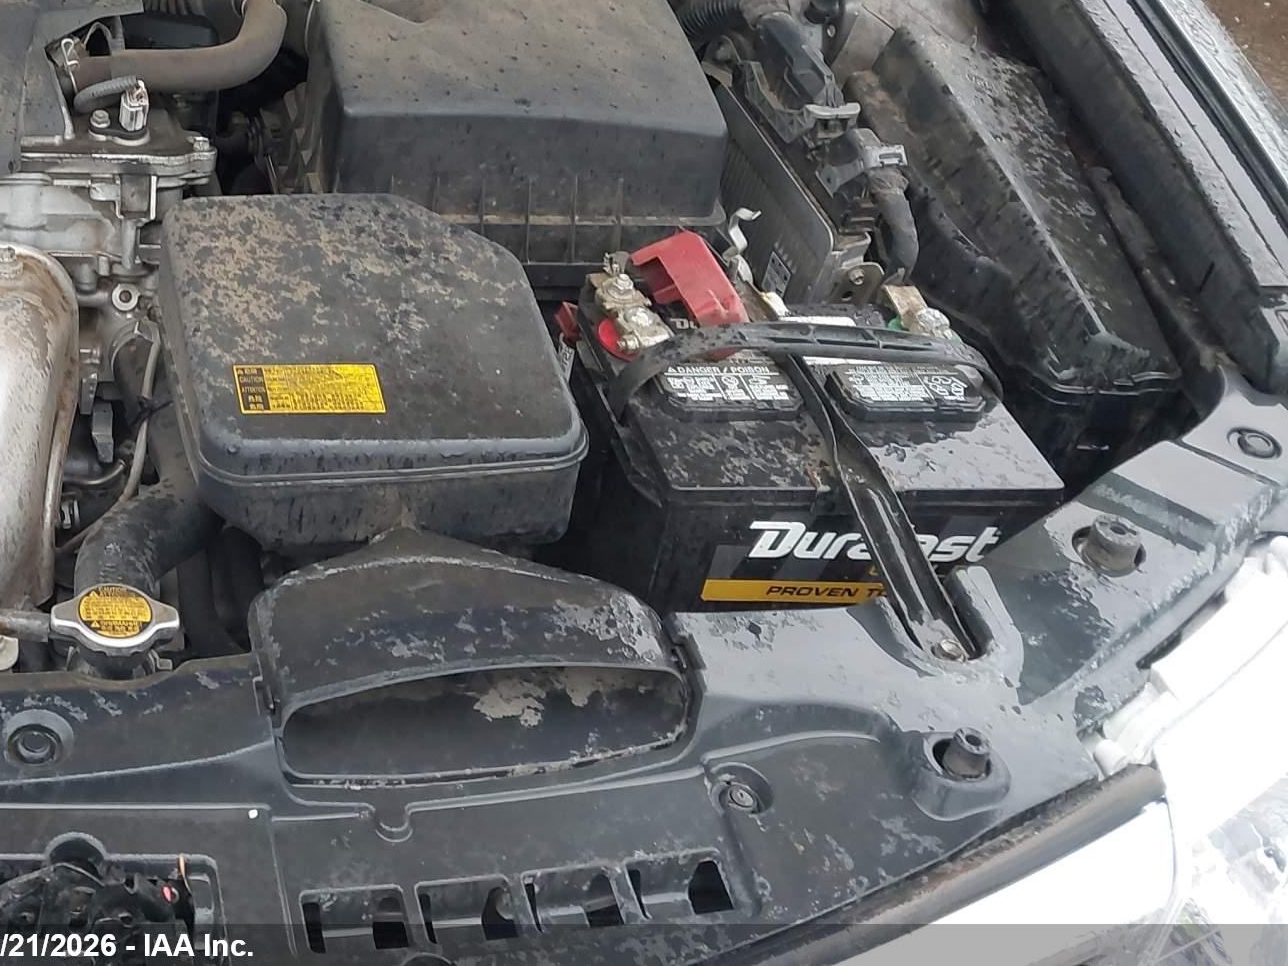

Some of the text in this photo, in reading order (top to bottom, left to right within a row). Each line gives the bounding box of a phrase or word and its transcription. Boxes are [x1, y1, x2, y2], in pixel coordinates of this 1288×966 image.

[676, 365, 721, 375] DANGER
[729, 365, 771, 375] POISON
[748, 521, 999, 563] Duraast
[766, 585, 859, 598] PROVEN
